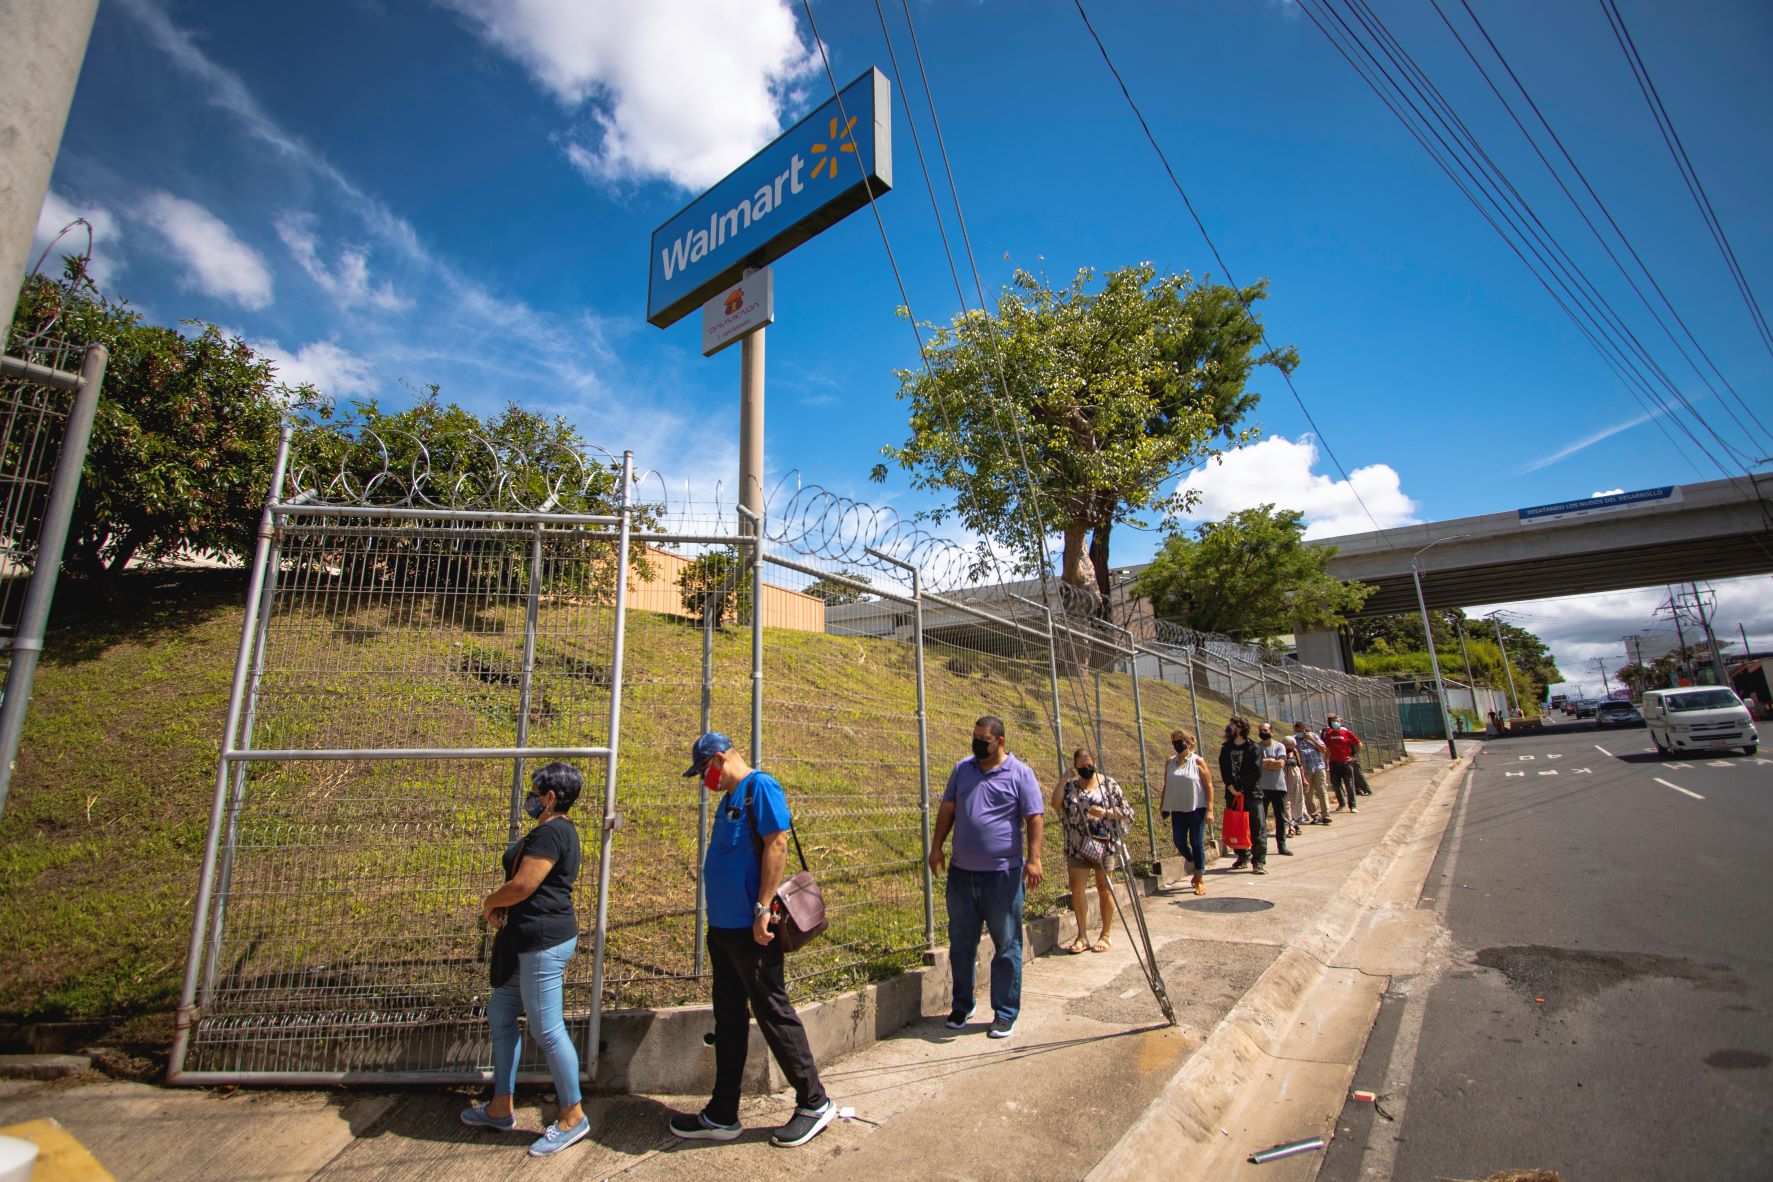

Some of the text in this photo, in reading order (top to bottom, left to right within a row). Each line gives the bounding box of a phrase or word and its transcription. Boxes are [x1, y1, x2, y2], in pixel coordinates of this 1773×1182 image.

[661, 153, 805, 281] Walmart
[1527, 505, 1565, 515] DESATANDO
[1579, 499, 1604, 507] NUDOS
[1618, 490, 1663, 502] DESARROLLO
